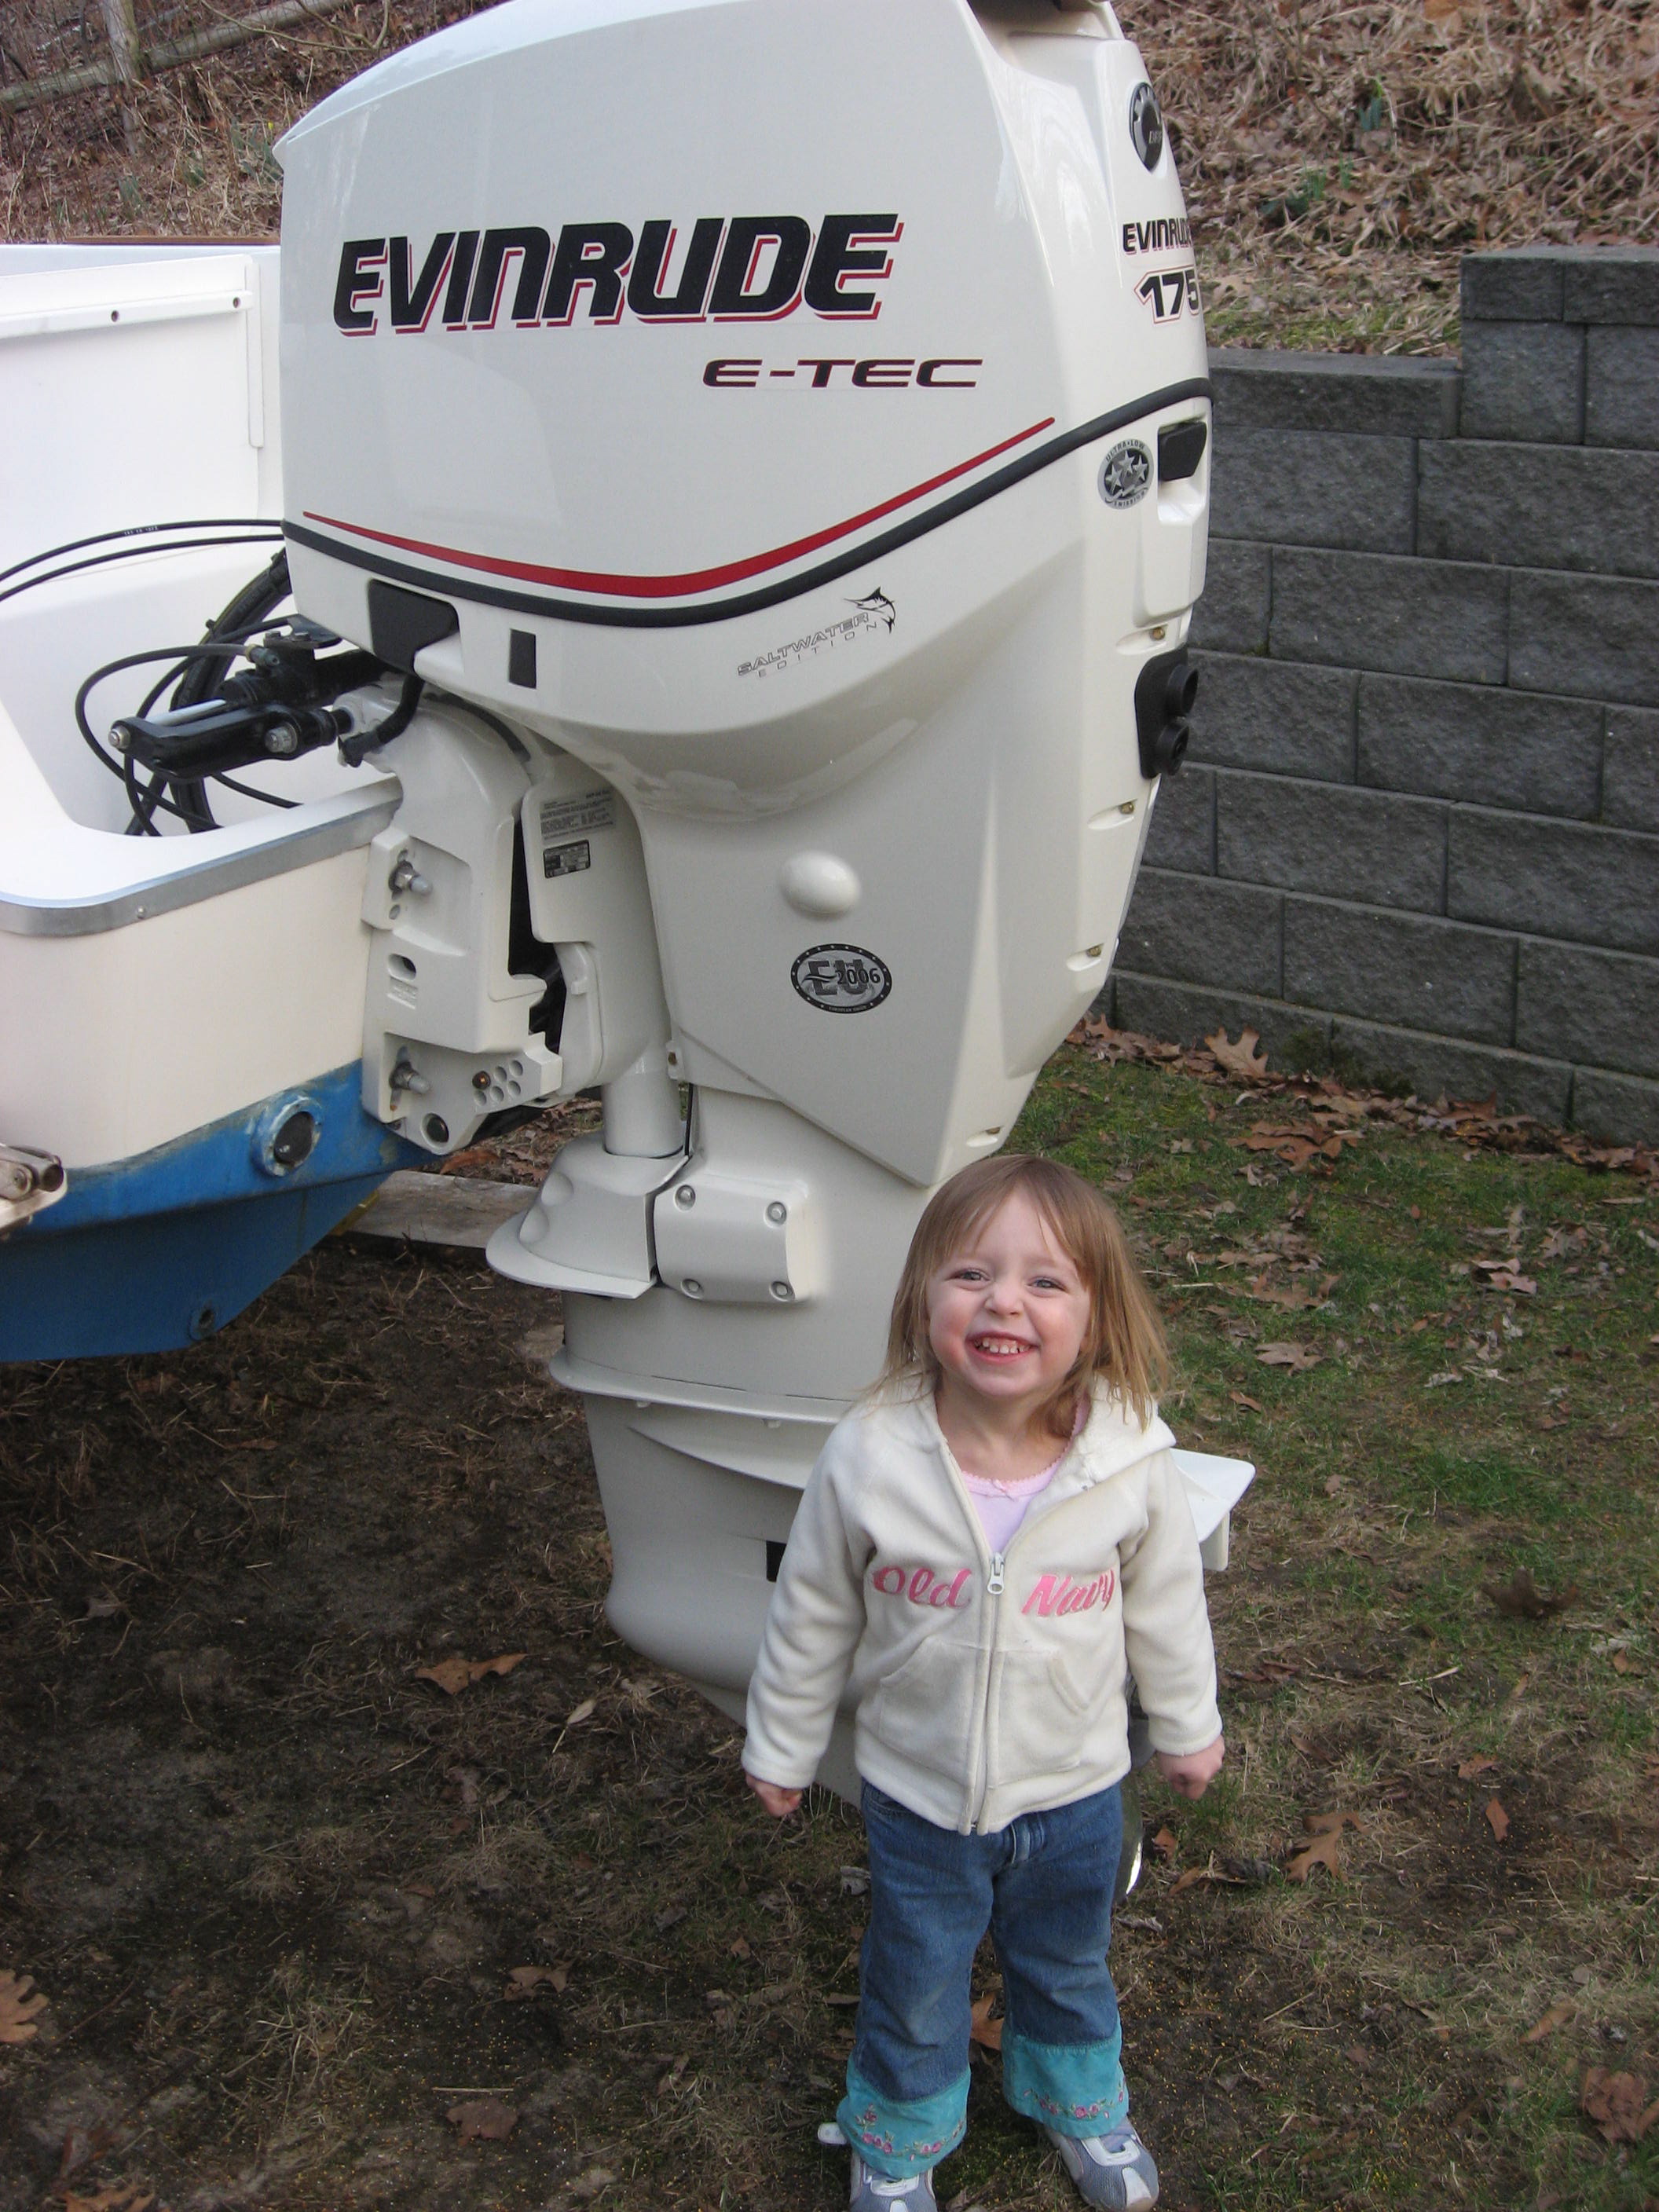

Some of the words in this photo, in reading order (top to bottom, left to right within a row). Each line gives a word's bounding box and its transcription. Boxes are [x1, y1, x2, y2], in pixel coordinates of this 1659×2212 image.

[333, 213, 905, 337] EVINRUDE
[1139, 269, 1199, 317] 175
[702, 358, 984, 389] E-TEC
[737, 612, 870, 676] SALTWATER
[758, 622, 877, 678] EDITION
[834, 967, 881, 985] 2006
[873, 1566, 972, 1609] Old
[1021, 1567, 1115, 1617] Navy
